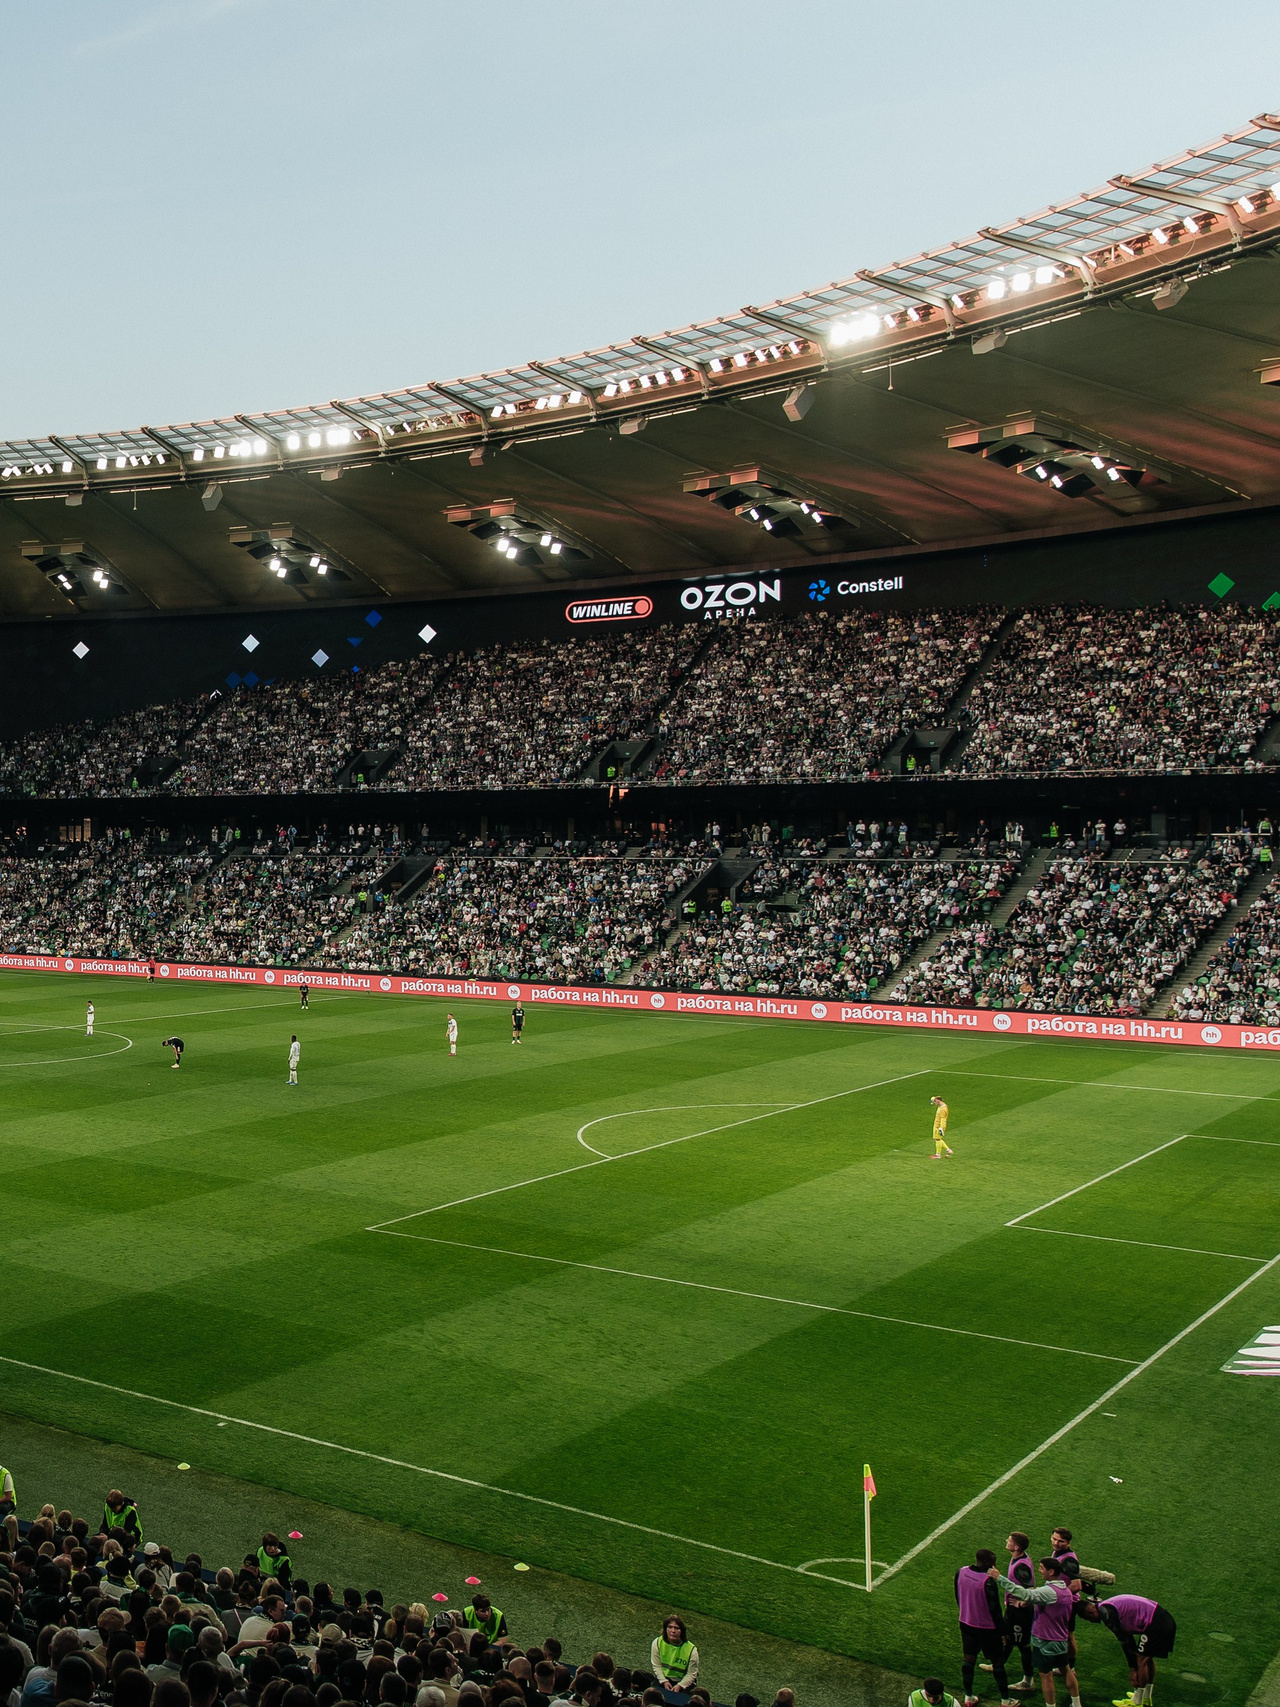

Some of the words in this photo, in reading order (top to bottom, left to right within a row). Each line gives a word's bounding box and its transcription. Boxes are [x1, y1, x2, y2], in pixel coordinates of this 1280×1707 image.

[837, 576, 903, 595] Constell
[680, 579, 781, 610] OZON
[572, 602, 634, 619] WINLINE
[704, 607, 756, 620] АРЕНА
[24, 958, 34, 966] на
[36, 958, 57, 968] hh.ru
[81, 962, 113, 972] работа
[115, 964, 126, 972] на
[178, 966, 213, 978] работа
[215, 969, 227, 978] на
[230, 969, 255, 980] hh.ru
[284, 973, 323, 985] работа
[326, 976, 339, 985] на
[341, 975, 370, 987] hh.ru
[402, 980, 445, 992] работа
[447, 984, 462, 993] на
[465, 983, 496, 995] hh.ru
[532, 987, 580, 1001] работа
[583, 992, 599, 1002] на
[603, 991, 638, 1004] hh.ru
[678, 997, 732, 1010] работа
[735, 1001, 754, 1011] на
[757, 1000, 797, 1014] hh.ru
[842, 1006, 903, 1021] работа
[907, 1012, 928, 1022] на
[932, 1010, 977, 1026] hh.ru
[1028, 1017, 1098, 1033] работа
[1102, 1024, 1126, 1035] на
[1131, 1022, 1182, 1039] hh.ru
[1013, 1632, 1023, 1643] 17
[1137, 1641, 1145, 1653] 5
[674, 1656, 688, 1666] 270
